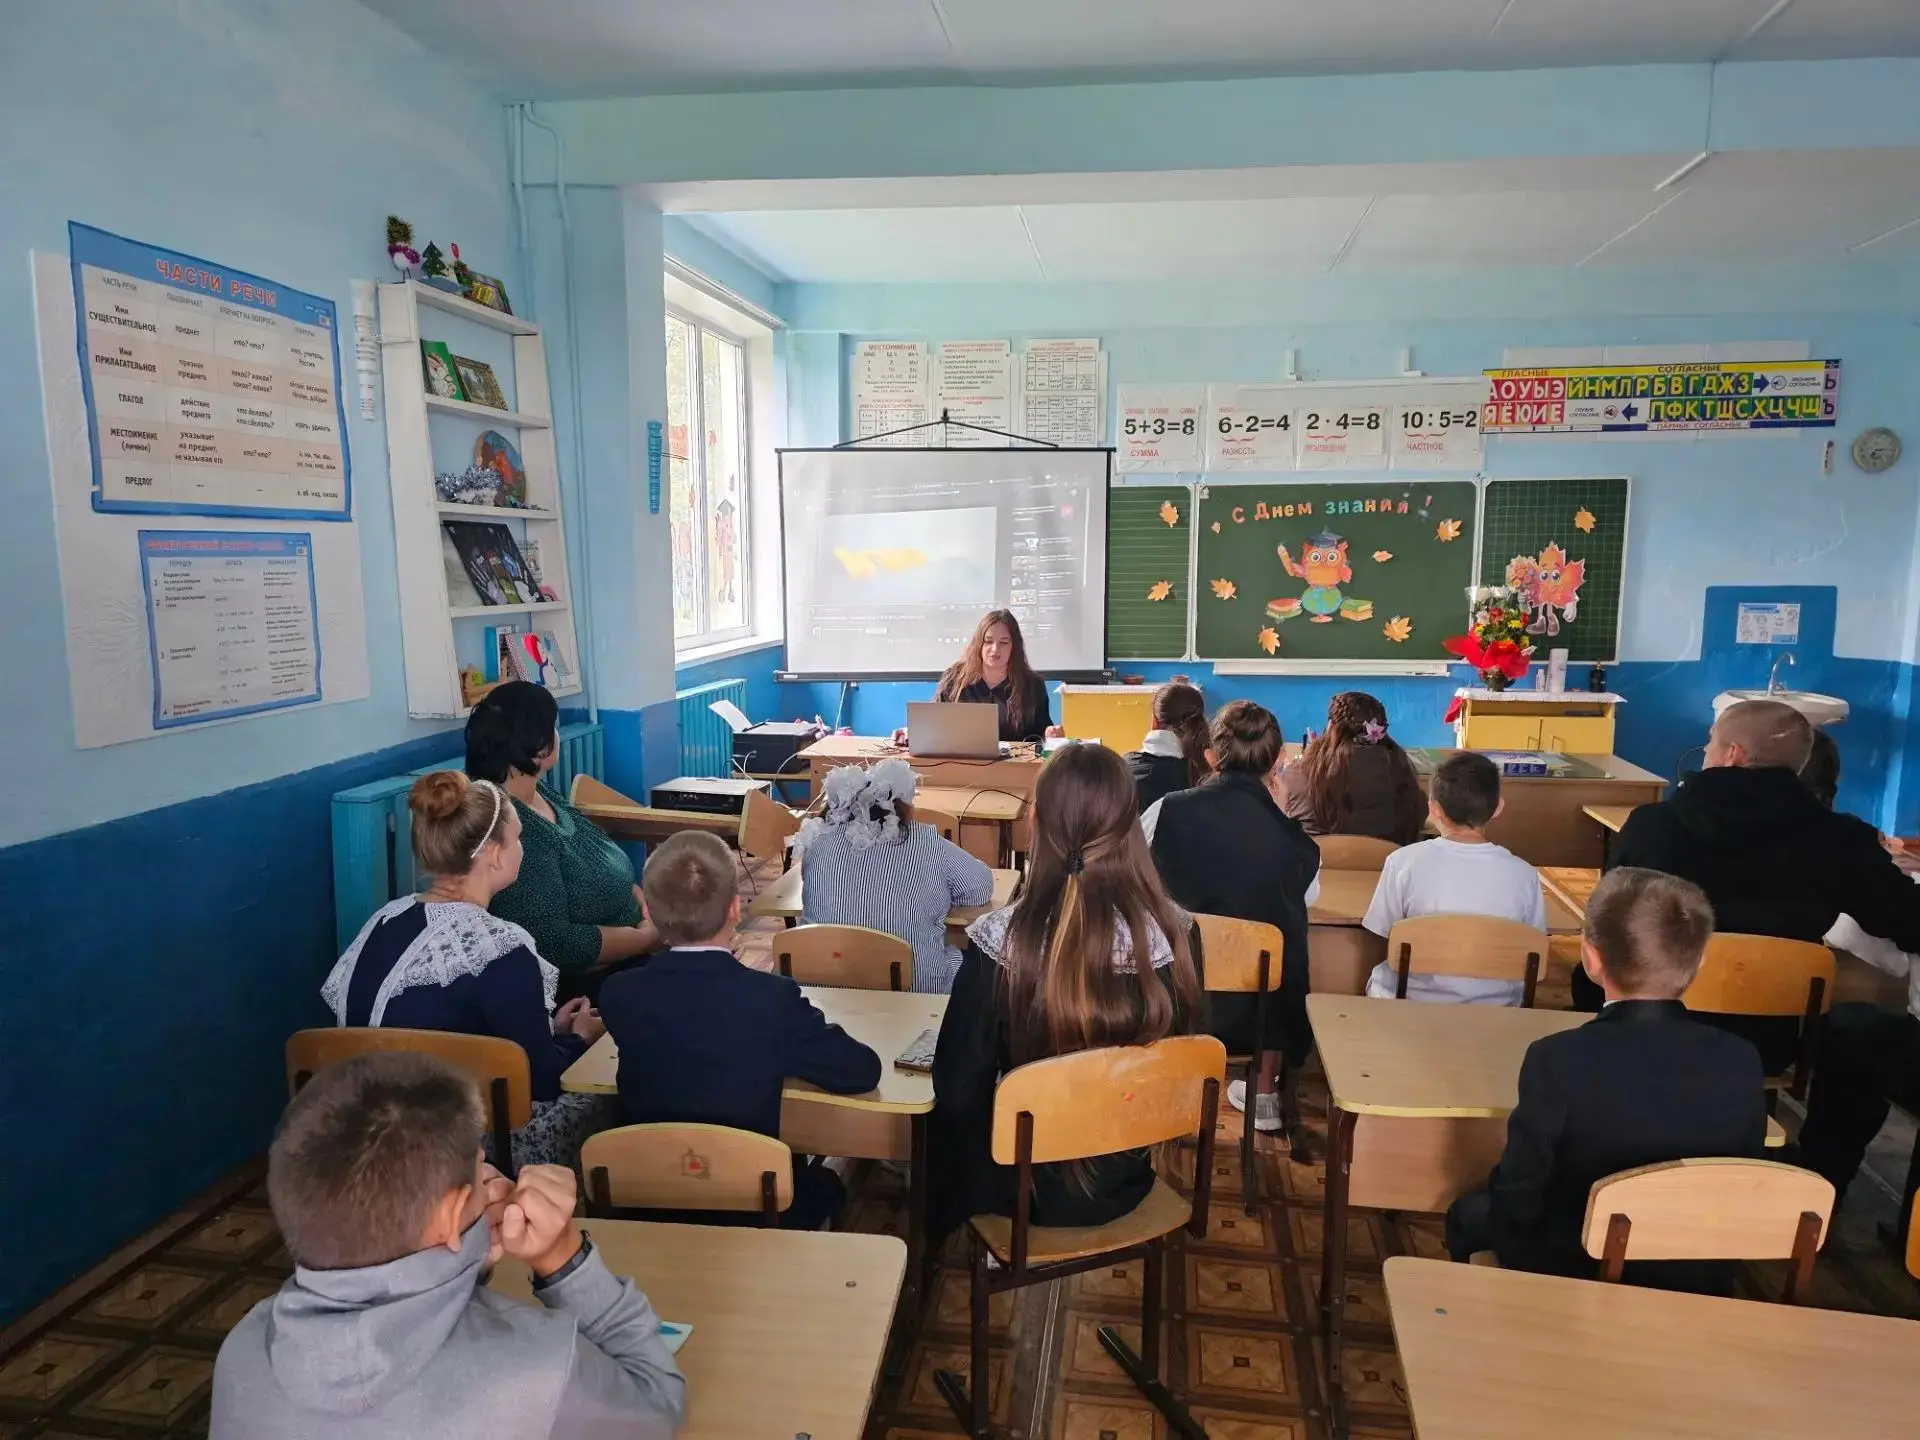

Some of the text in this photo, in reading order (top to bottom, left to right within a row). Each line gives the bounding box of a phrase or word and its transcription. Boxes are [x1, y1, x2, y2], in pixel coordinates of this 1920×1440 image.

[156, 258, 222, 292] ЧАСТИ
[230, 280, 277, 307] РЕЧИ
[114, 305, 129, 314] Имя
[89, 311, 157, 333] СУЩЕСТВИТЕЛЬНОЕ
[95, 354, 157, 373] ПРИЛАГАТЕЛЬНОЕ
[1657, 364, 1721, 373] СОГЛАСНЫЕ
[1501, 369, 1549, 377] ГЛАСНЫЕ
[118, 394, 144, 405] ГЛАГОЛ
[1124, 418, 1195, 436] 5+3=8
[1694, 421, 1745, 429] СОГЛАСНЫЕ
[110, 427, 158, 440] МЕСТОИМЕНИЕ
[1222, 447, 1256, 455] РАЗНОСТЬ
[1406, 442, 1444, 451] ЧАСТНОЕ
[1131, 449, 1160, 457] СУММА
[125, 476, 153, 487] ПРЕДЛОГ
[1254, 502, 1313, 521] Днем
